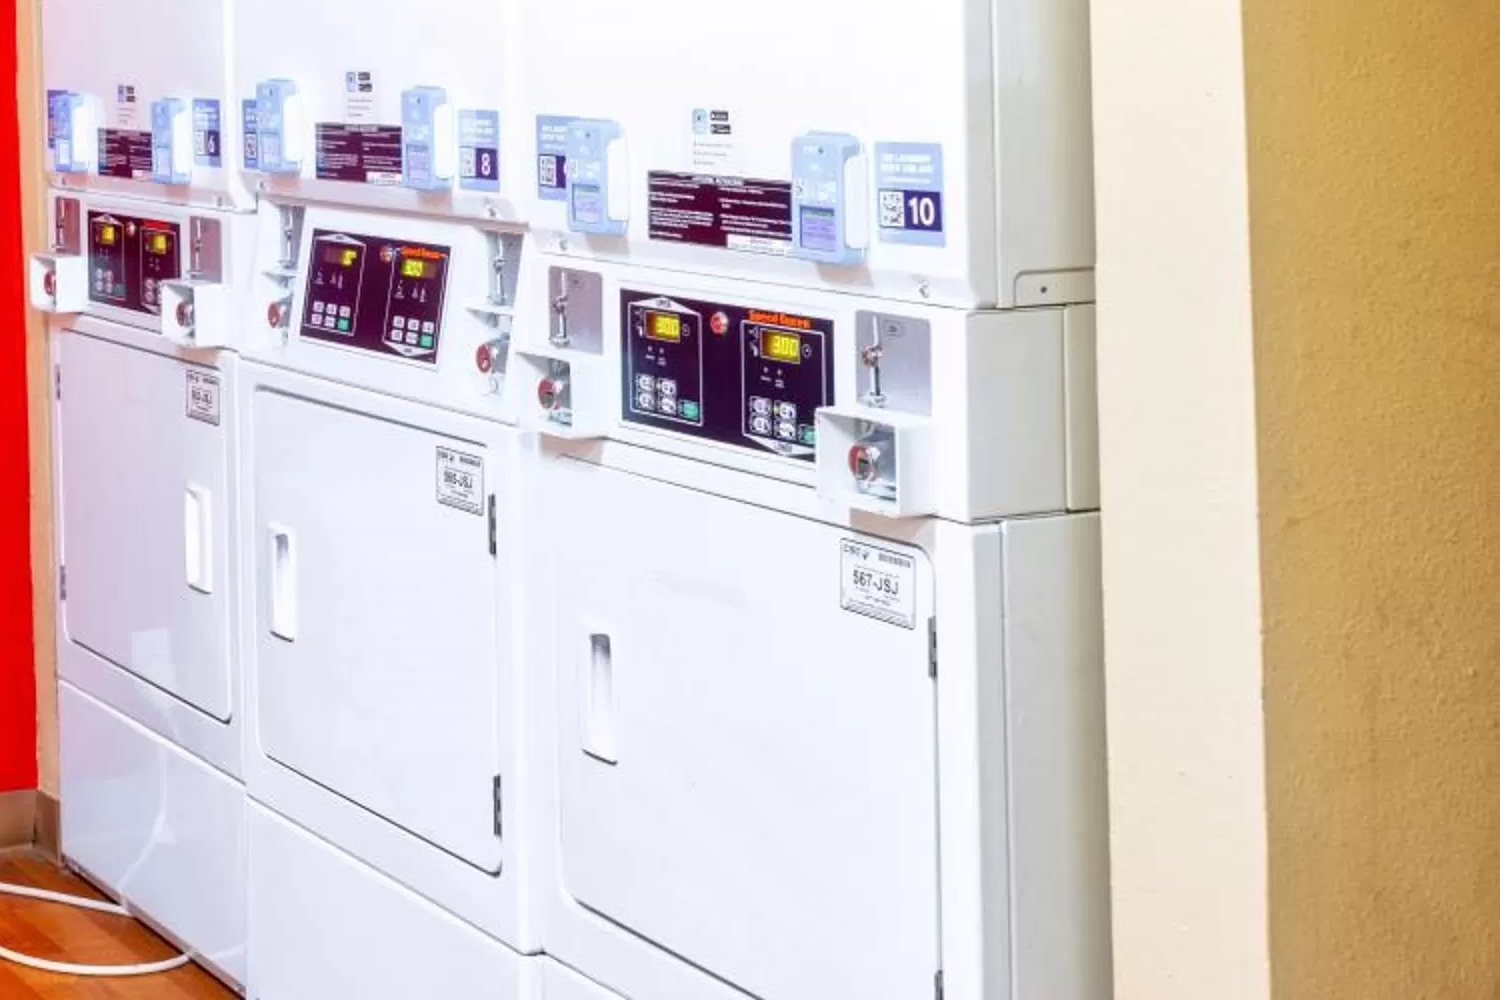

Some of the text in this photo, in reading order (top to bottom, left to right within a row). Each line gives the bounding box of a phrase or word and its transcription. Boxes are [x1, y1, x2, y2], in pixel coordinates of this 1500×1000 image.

[208, 135, 216, 153] 6
[481, 153, 491, 176] 8
[908, 197, 935, 226] 10
[853, 569, 899, 595] 567-JSJ
